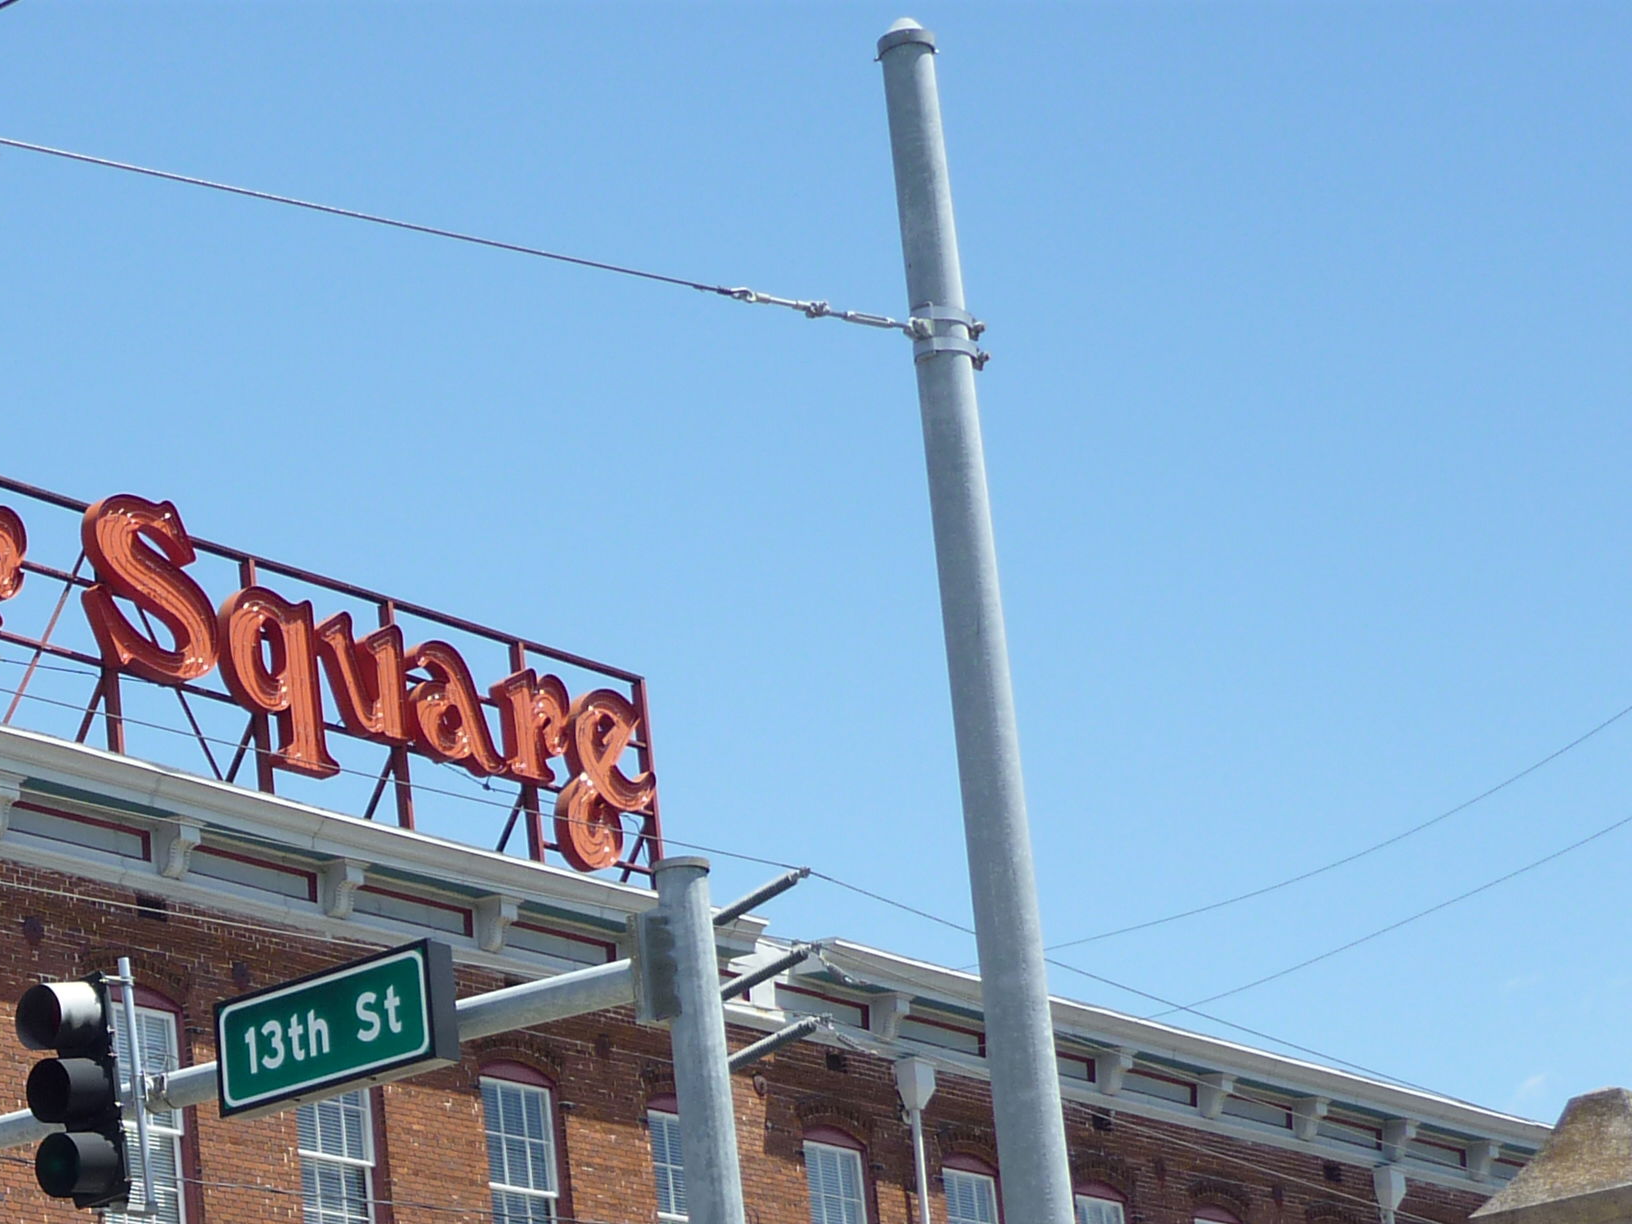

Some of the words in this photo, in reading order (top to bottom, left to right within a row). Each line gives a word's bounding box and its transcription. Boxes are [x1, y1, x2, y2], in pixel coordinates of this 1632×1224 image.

[80, 493, 657, 873] Square
[244, 1008, 330, 1075] 13th
[355, 984, 402, 1042] St
